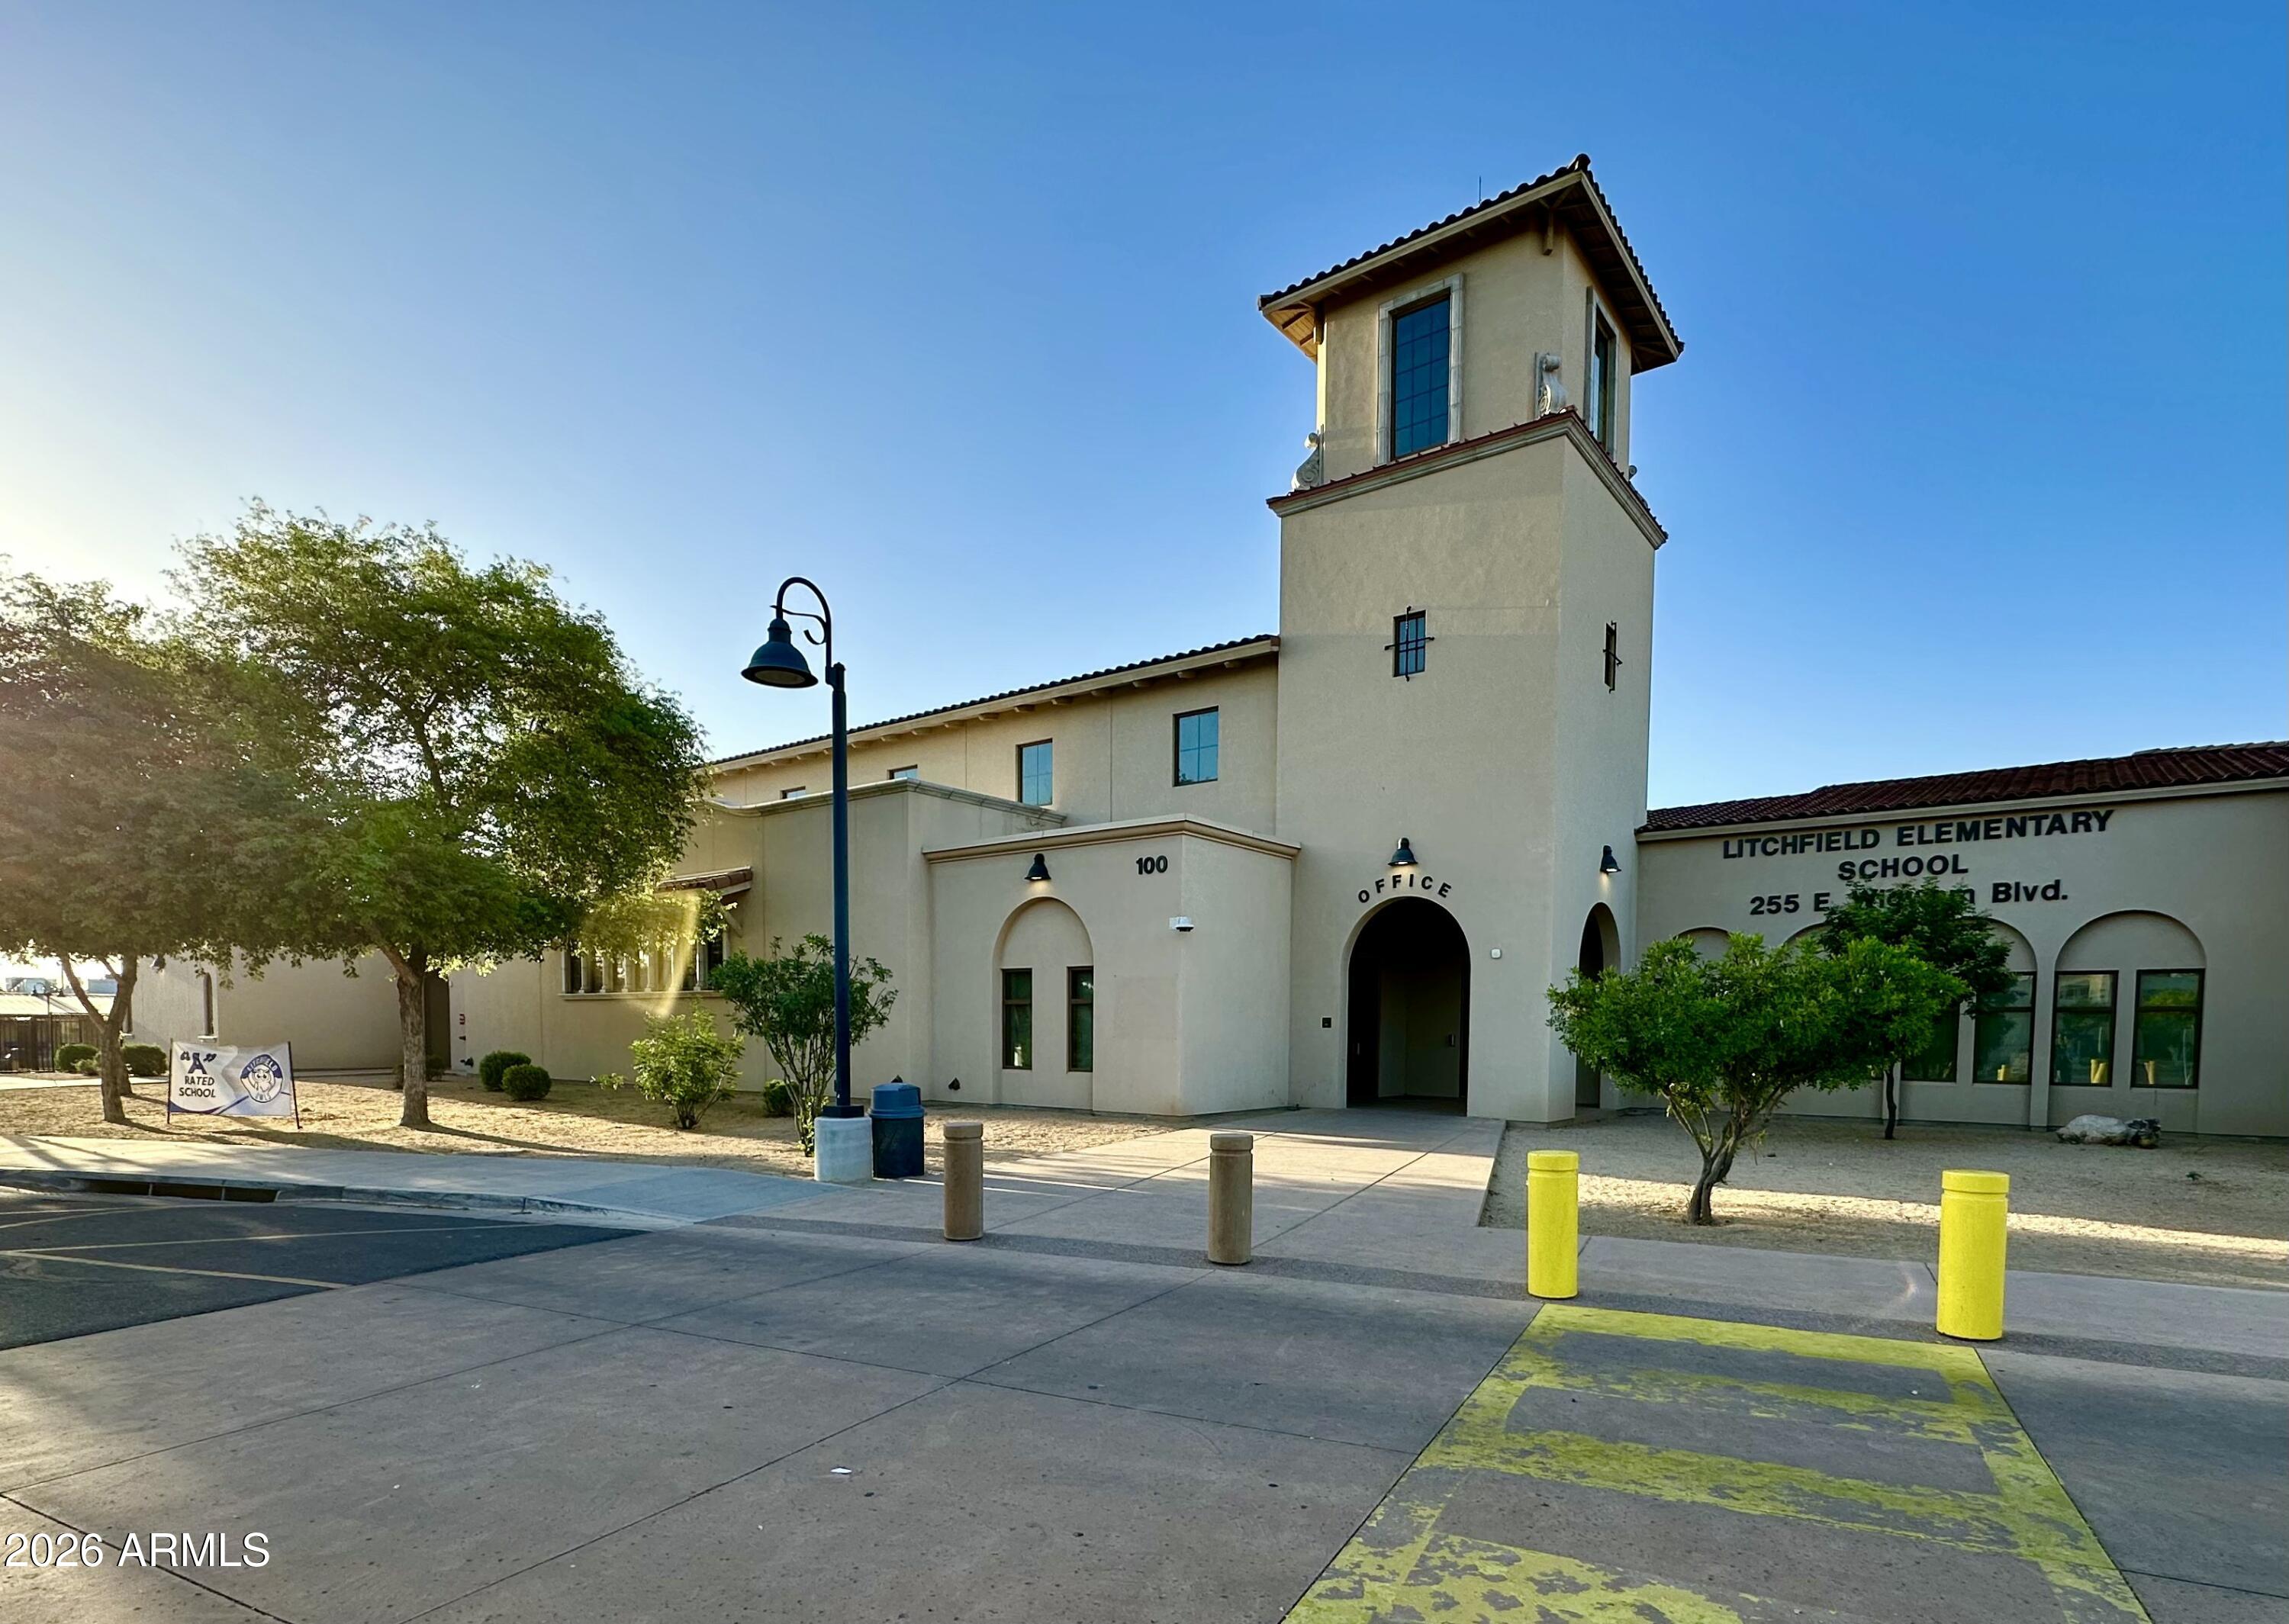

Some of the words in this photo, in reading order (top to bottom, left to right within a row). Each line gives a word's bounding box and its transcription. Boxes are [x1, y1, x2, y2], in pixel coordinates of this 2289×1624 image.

[1723, 828, 1881, 859] LITCHFIELD
[1896, 809, 2115, 847] ELEMENTARY
[1135, 855, 1169, 875] 100
[1837, 854, 1969, 880] SCHOOL
[1357, 873, 1452, 903] OFFICE
[1750, 894, 1800, 915] 255
[1991, 879, 2068, 903] Blvd.
[179, 1087, 216, 1098] SCHOOL
[184, 1076, 215, 1086] RATED
